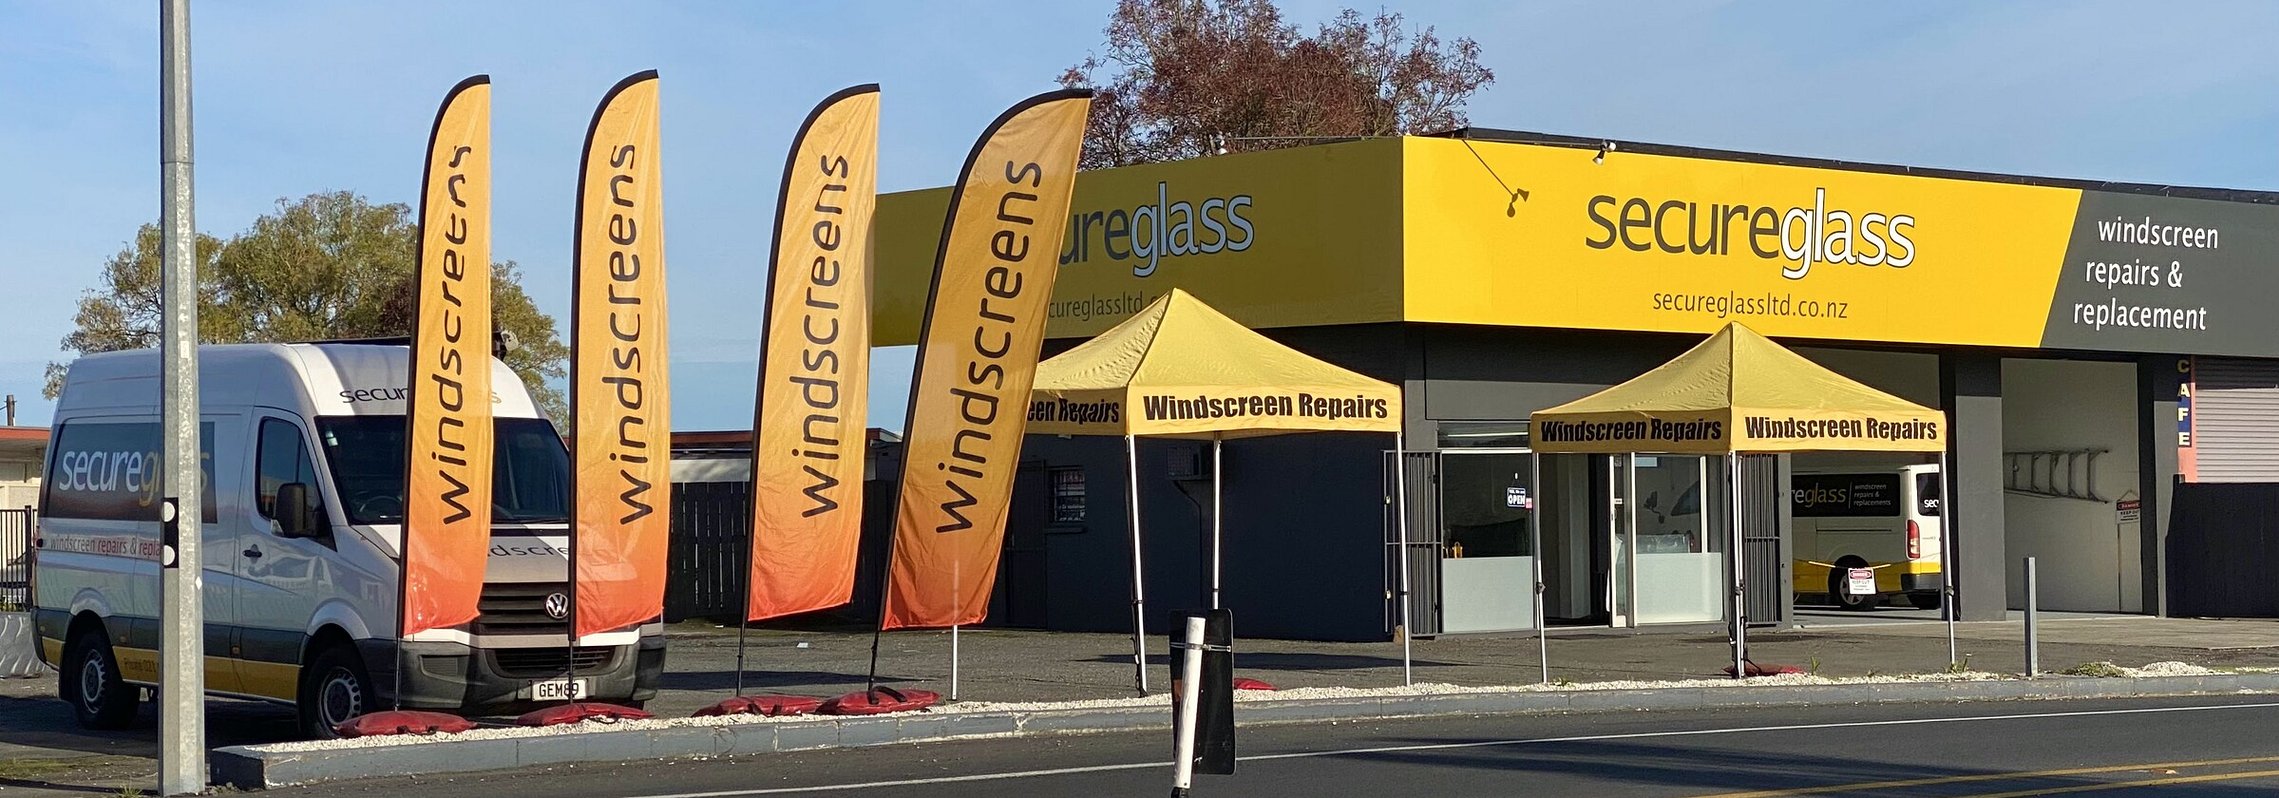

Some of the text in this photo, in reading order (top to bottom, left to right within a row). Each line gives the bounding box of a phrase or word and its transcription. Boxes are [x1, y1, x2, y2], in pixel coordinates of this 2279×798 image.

[1060, 181, 1255, 278] ureglass
[1586, 187, 1915, 280] secureglass
[2098, 216, 2218, 249] windscreen
[2086, 258, 2183, 290] repairs &
[1653, 290, 1849, 319] secureglassltd.co.nz
[2074, 298, 2207, 331] replacement
[432, 146, 472, 525] windscreens
[602, 145, 654, 525] windscreens
[790, 155, 848, 518] windscreens
[937, 160, 1042, 535] windscreens
[1058, 398, 1120, 425] Repairs
[1143, 393, 1388, 421] Windscreen Repairs
[1541, 417, 1722, 443] Windscreen Repairs
[1745, 416, 1938, 441] Windscreen Repairs
[1507, 494, 1526, 505] OPEN
[51, 535, 96, 551] windscreen
[97, 536, 127, 554] repairs
[130, 535, 137, 553] &
[539, 682, 579, 698] GEM89
